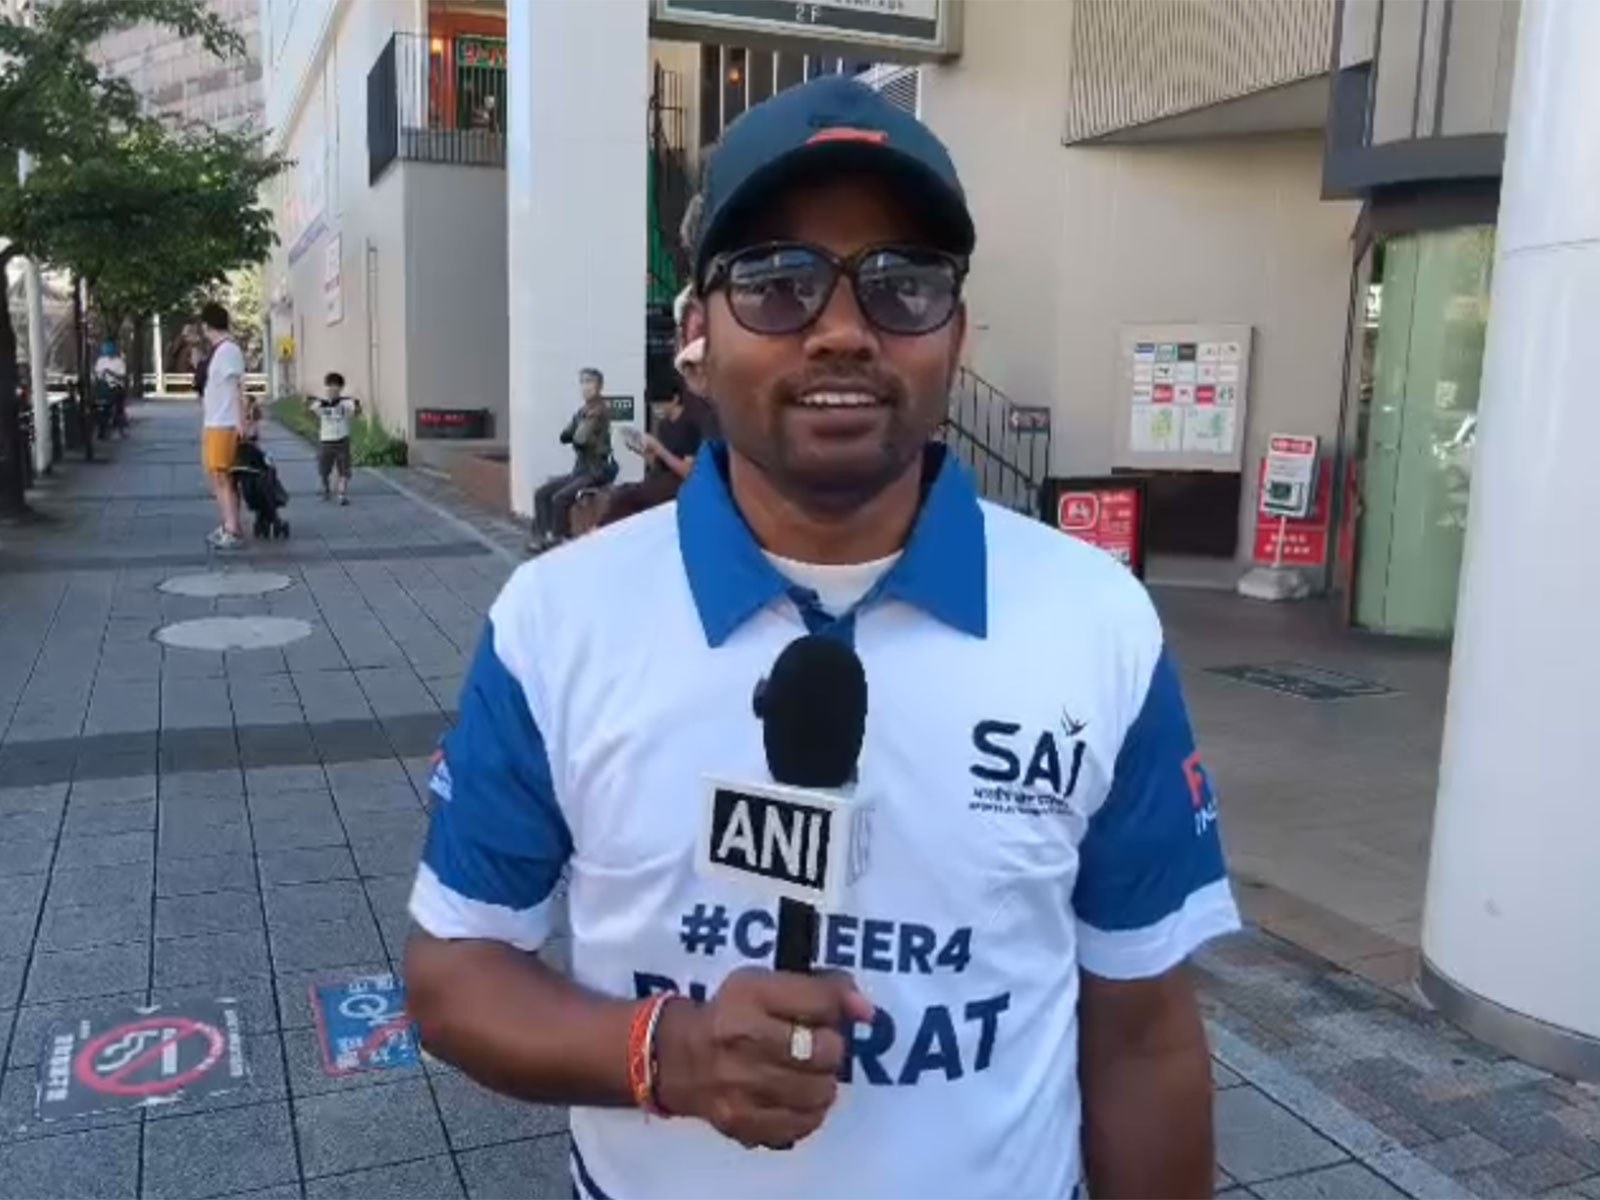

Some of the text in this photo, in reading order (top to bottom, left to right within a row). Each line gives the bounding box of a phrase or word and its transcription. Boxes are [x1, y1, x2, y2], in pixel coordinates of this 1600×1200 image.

[969, 716, 1087, 798] SAI
[716, 799, 823, 881] ANI
[679, 903, 973, 973] #CEER4
